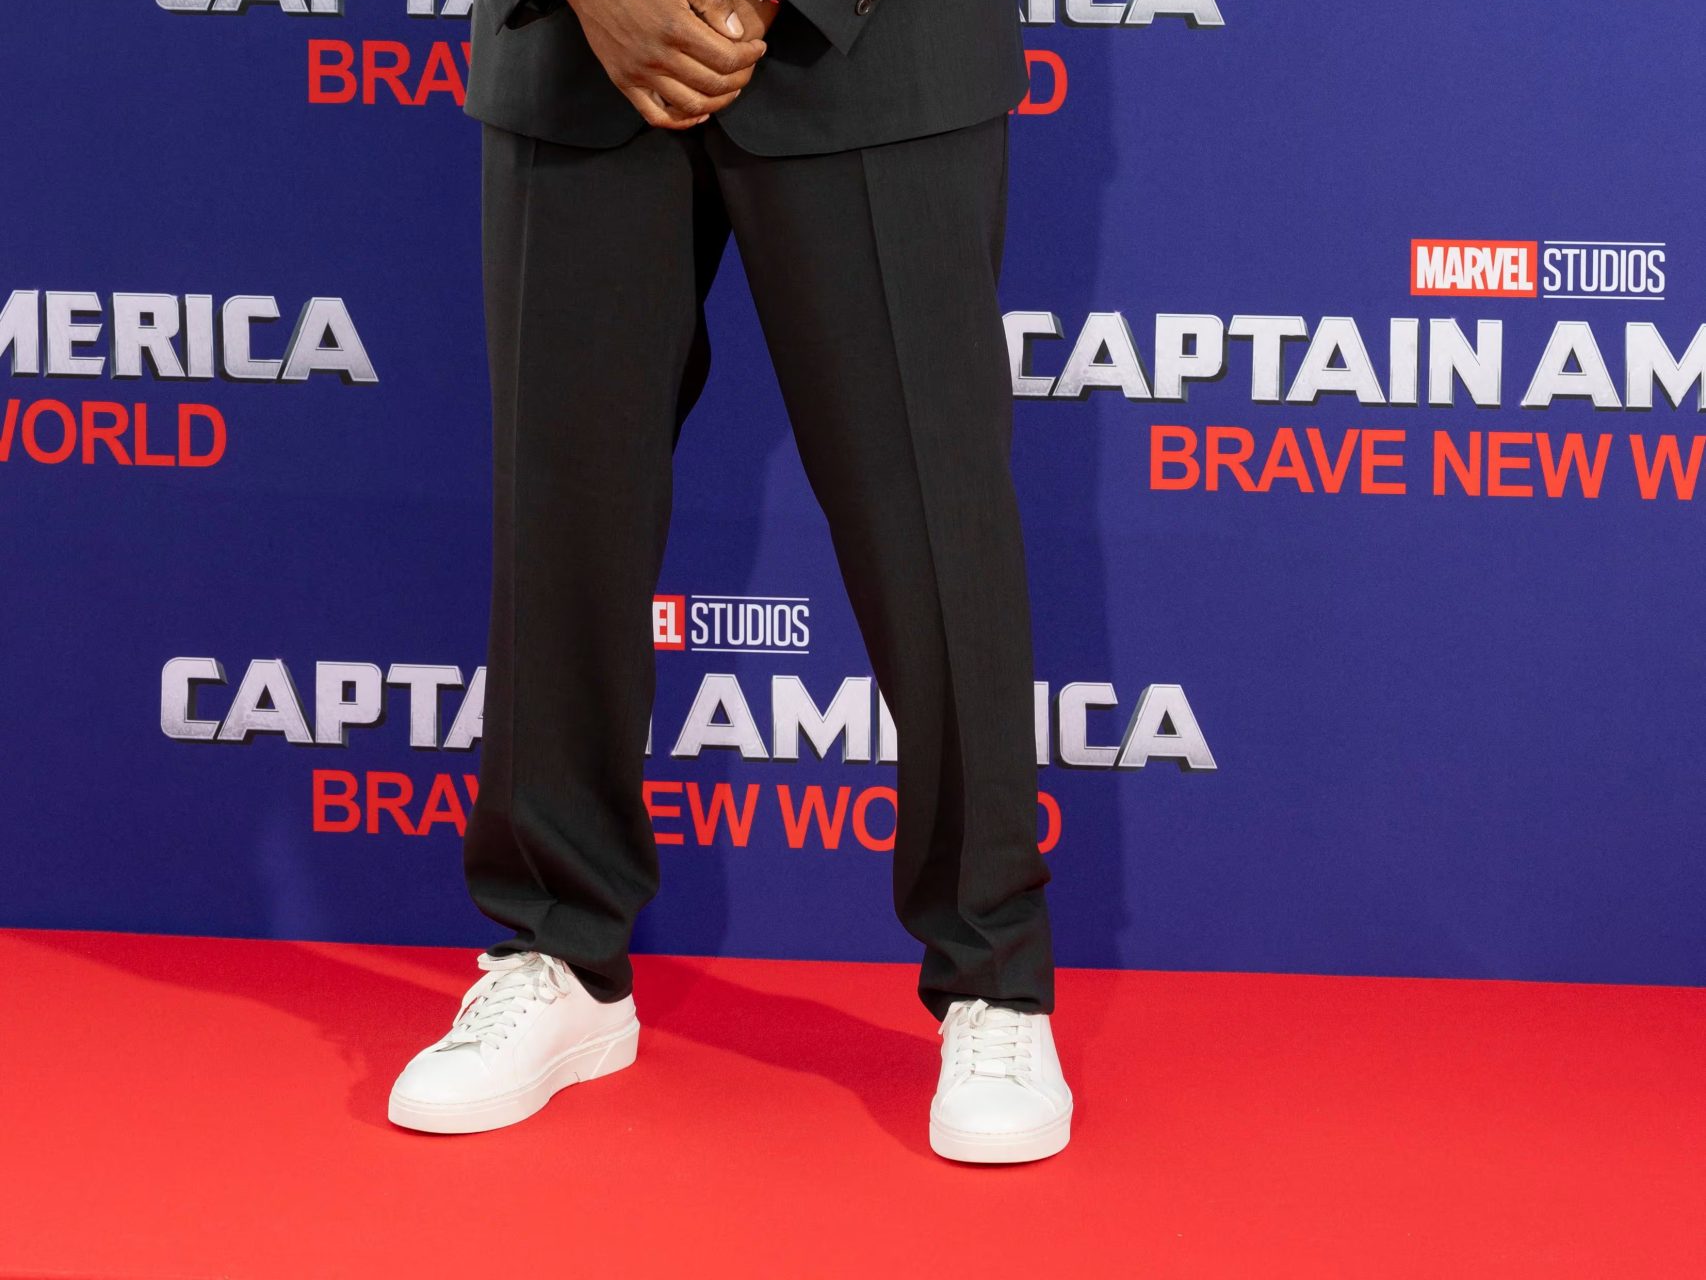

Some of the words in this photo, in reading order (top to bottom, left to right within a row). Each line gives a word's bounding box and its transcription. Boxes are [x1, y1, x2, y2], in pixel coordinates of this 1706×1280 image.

[308, 39, 472, 106] BRA
[1416, 245, 1534, 291] MARVEL
[1543, 247, 1666, 293] STUDIOS
[1001, 310, 1503, 407] CAPTAIN
[0, 398, 227, 467] ORLD
[1150, 425, 1407, 495] BRAVE
[1433, 431, 1613, 499] NEW
[652, 601, 682, 644] EL
[691, 602, 810, 647] STUDIOS
[313, 769, 480, 837] BRA
[642, 780, 761, 848] EW
